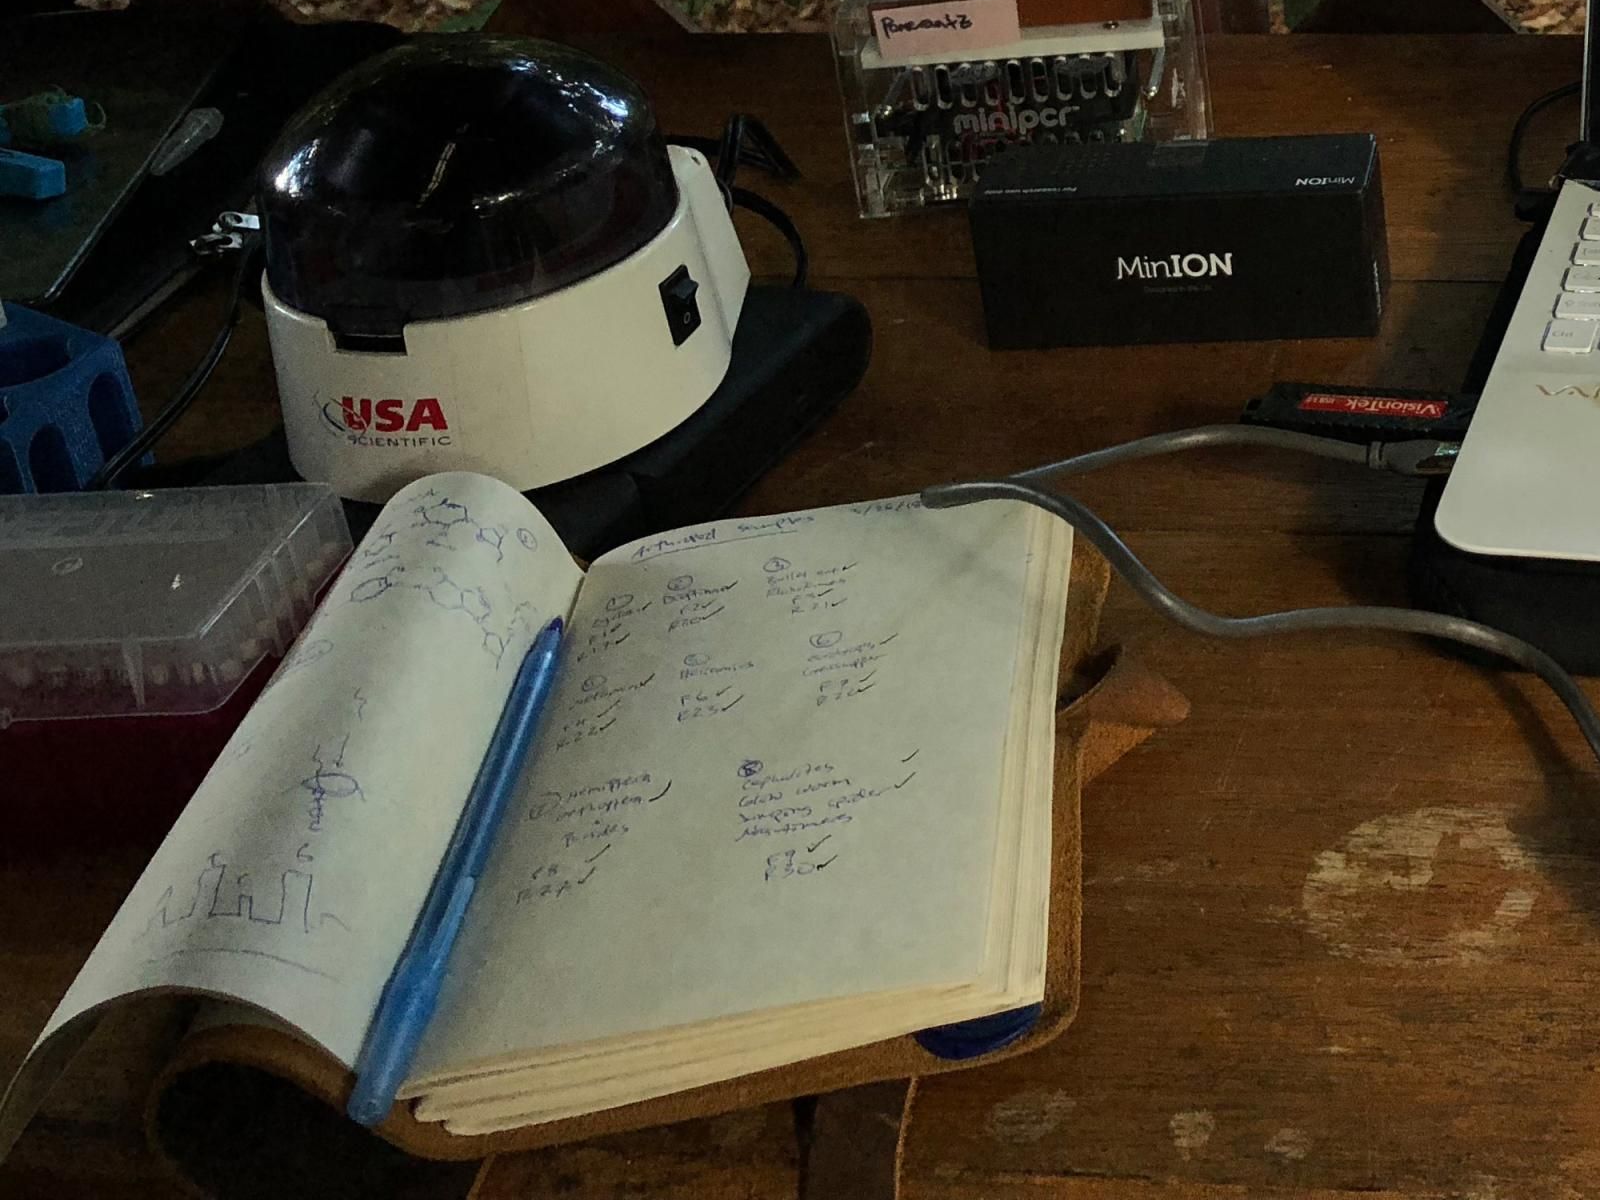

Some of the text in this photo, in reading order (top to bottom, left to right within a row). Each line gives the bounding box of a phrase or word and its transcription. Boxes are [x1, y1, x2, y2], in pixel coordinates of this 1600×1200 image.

[1295, 176, 1356, 186] MinION
[1117, 252, 1233, 280] MinION
[342, 396, 449, 433] USA
[1346, 398, 1438, 415] VisionTek
[347, 435, 452, 448] SCIENTIFIC
